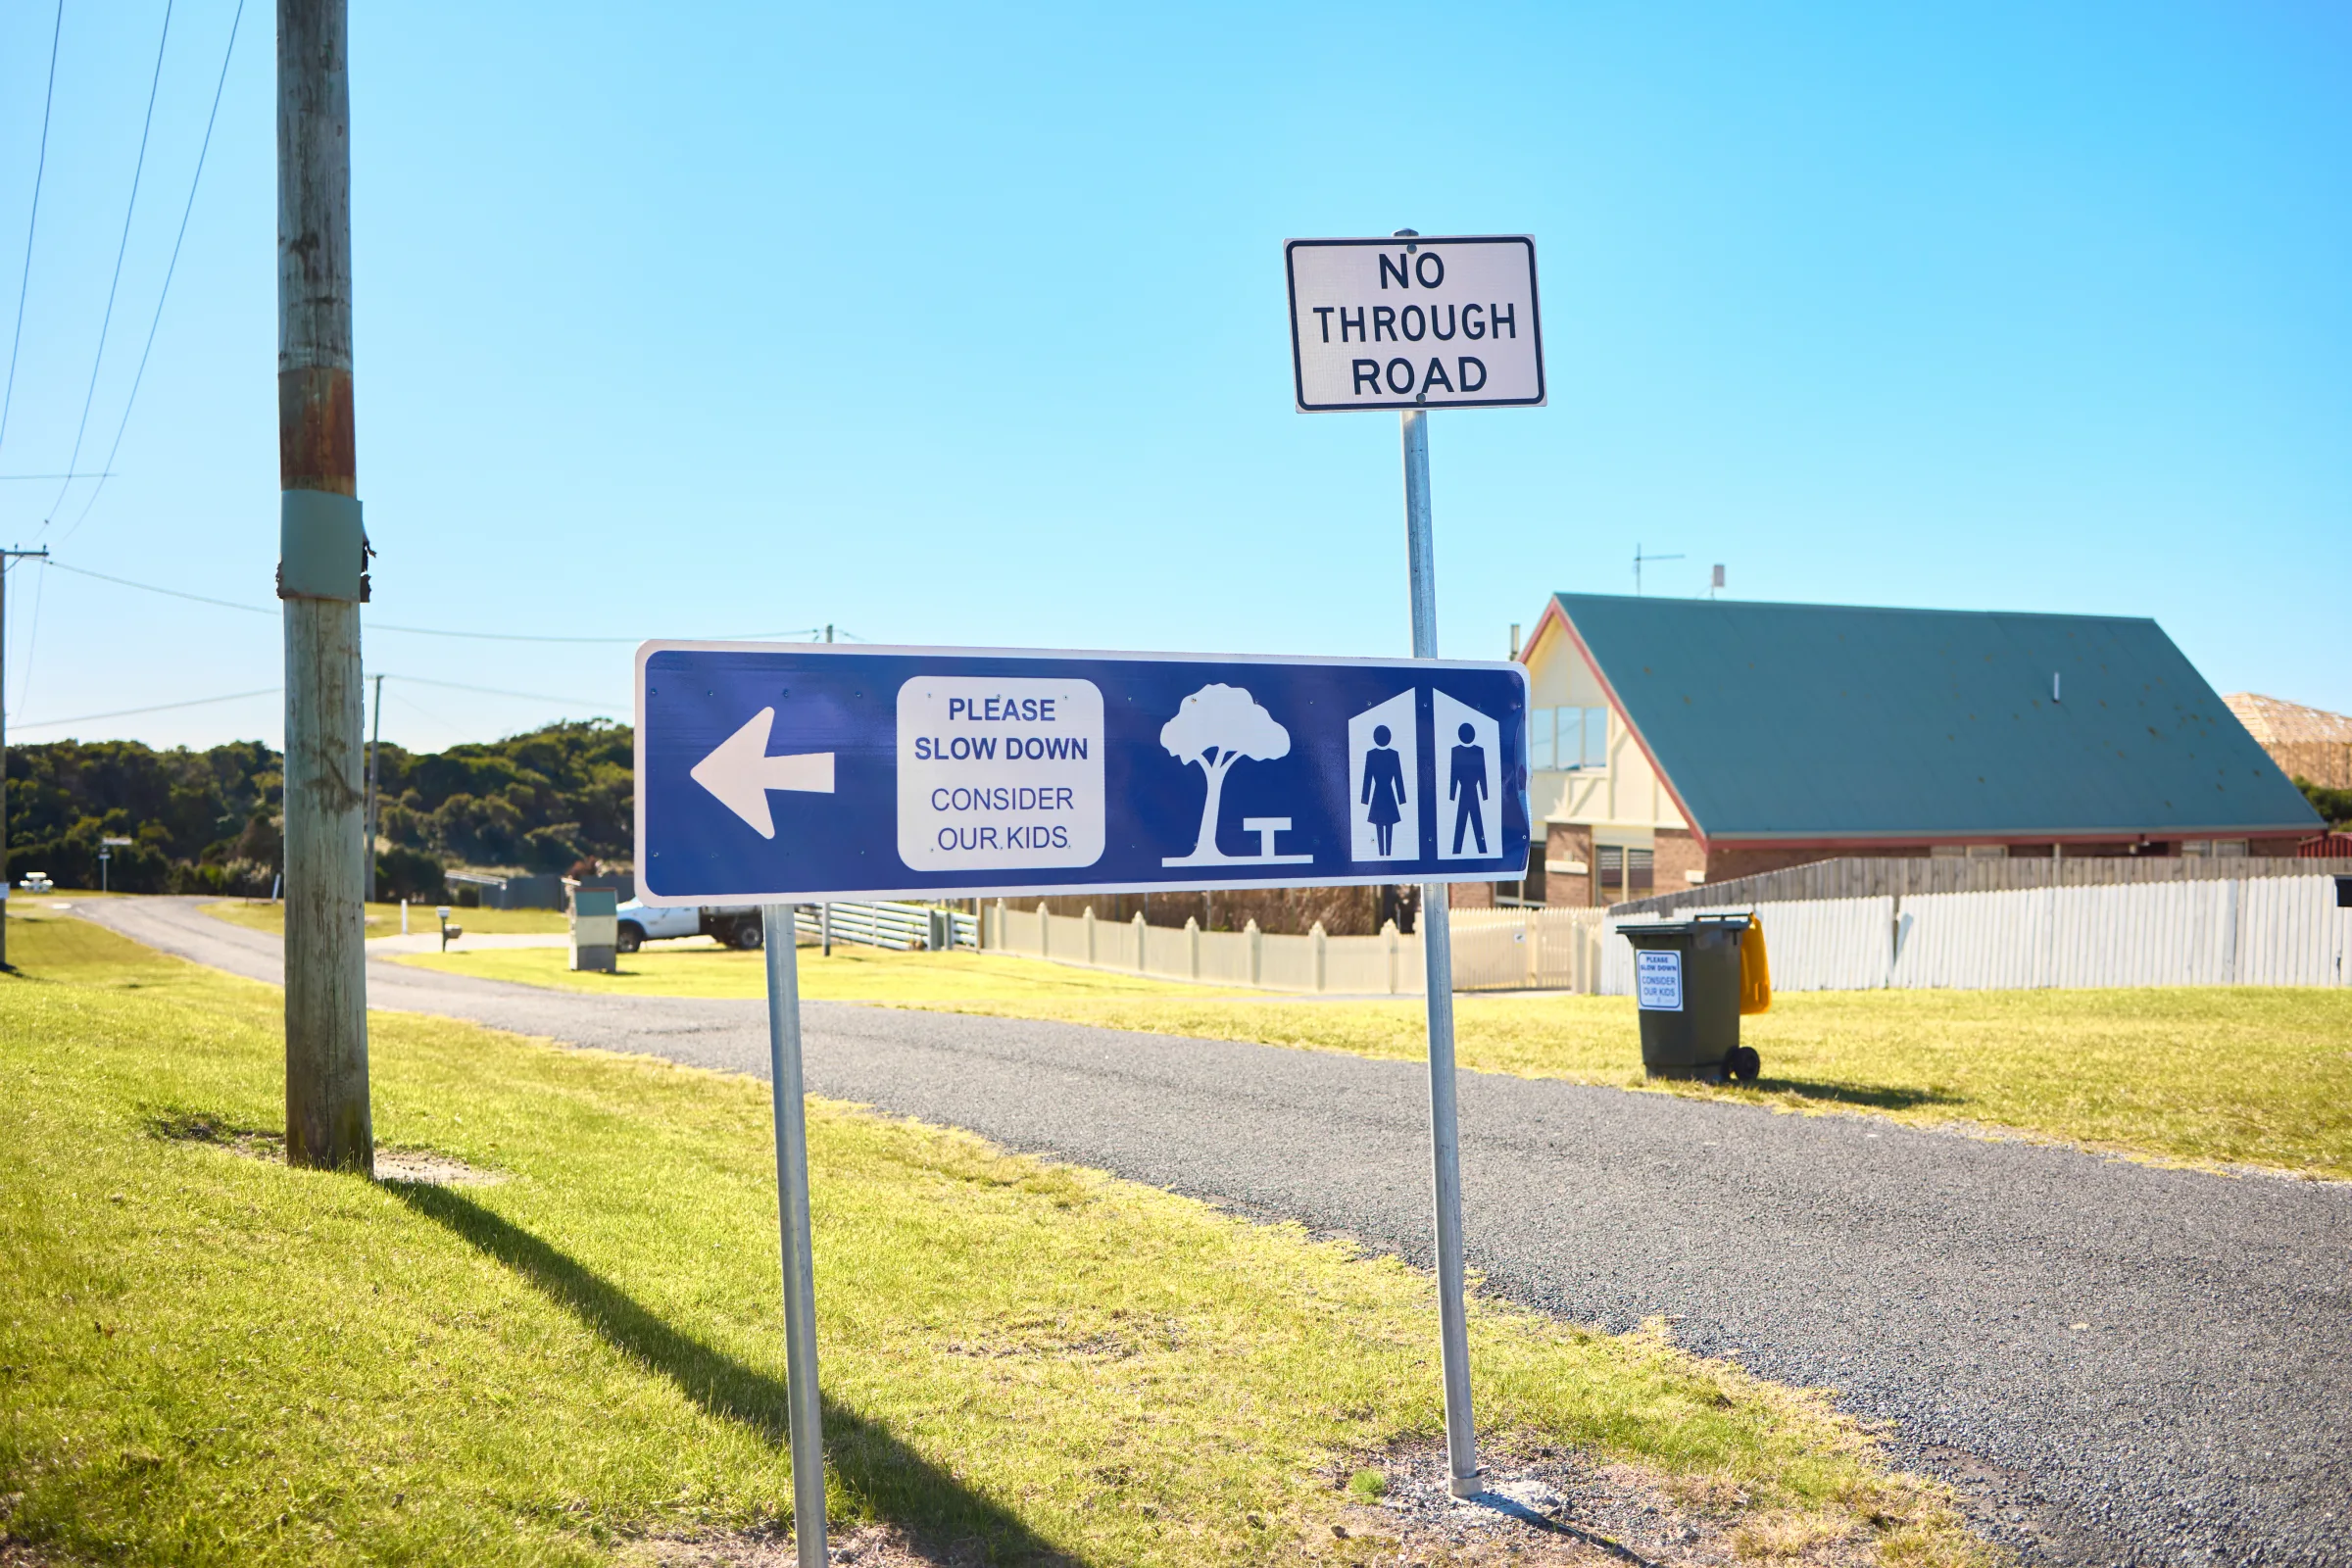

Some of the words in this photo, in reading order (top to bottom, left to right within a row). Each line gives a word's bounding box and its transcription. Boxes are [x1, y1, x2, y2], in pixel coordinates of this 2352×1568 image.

[1379, 252, 1445, 289] NO
[1313, 303, 1516, 343] THROUGH
[1352, 357, 1487, 395] ROAD
[949, 698, 1055, 721] PLEASE
[914, 737, 998, 760] SLOW
[1005, 737, 1088, 760] DOWN
[931, 787, 1074, 811] CONSIDER
[938, 827, 999, 851] OUR
[1007, 825, 1068, 849] KIDS
[1642, 976, 1676, 985] CONSIDER
[1644, 987, 1657, 996] OUR
[1659, 988, 1675, 997] KIDS
